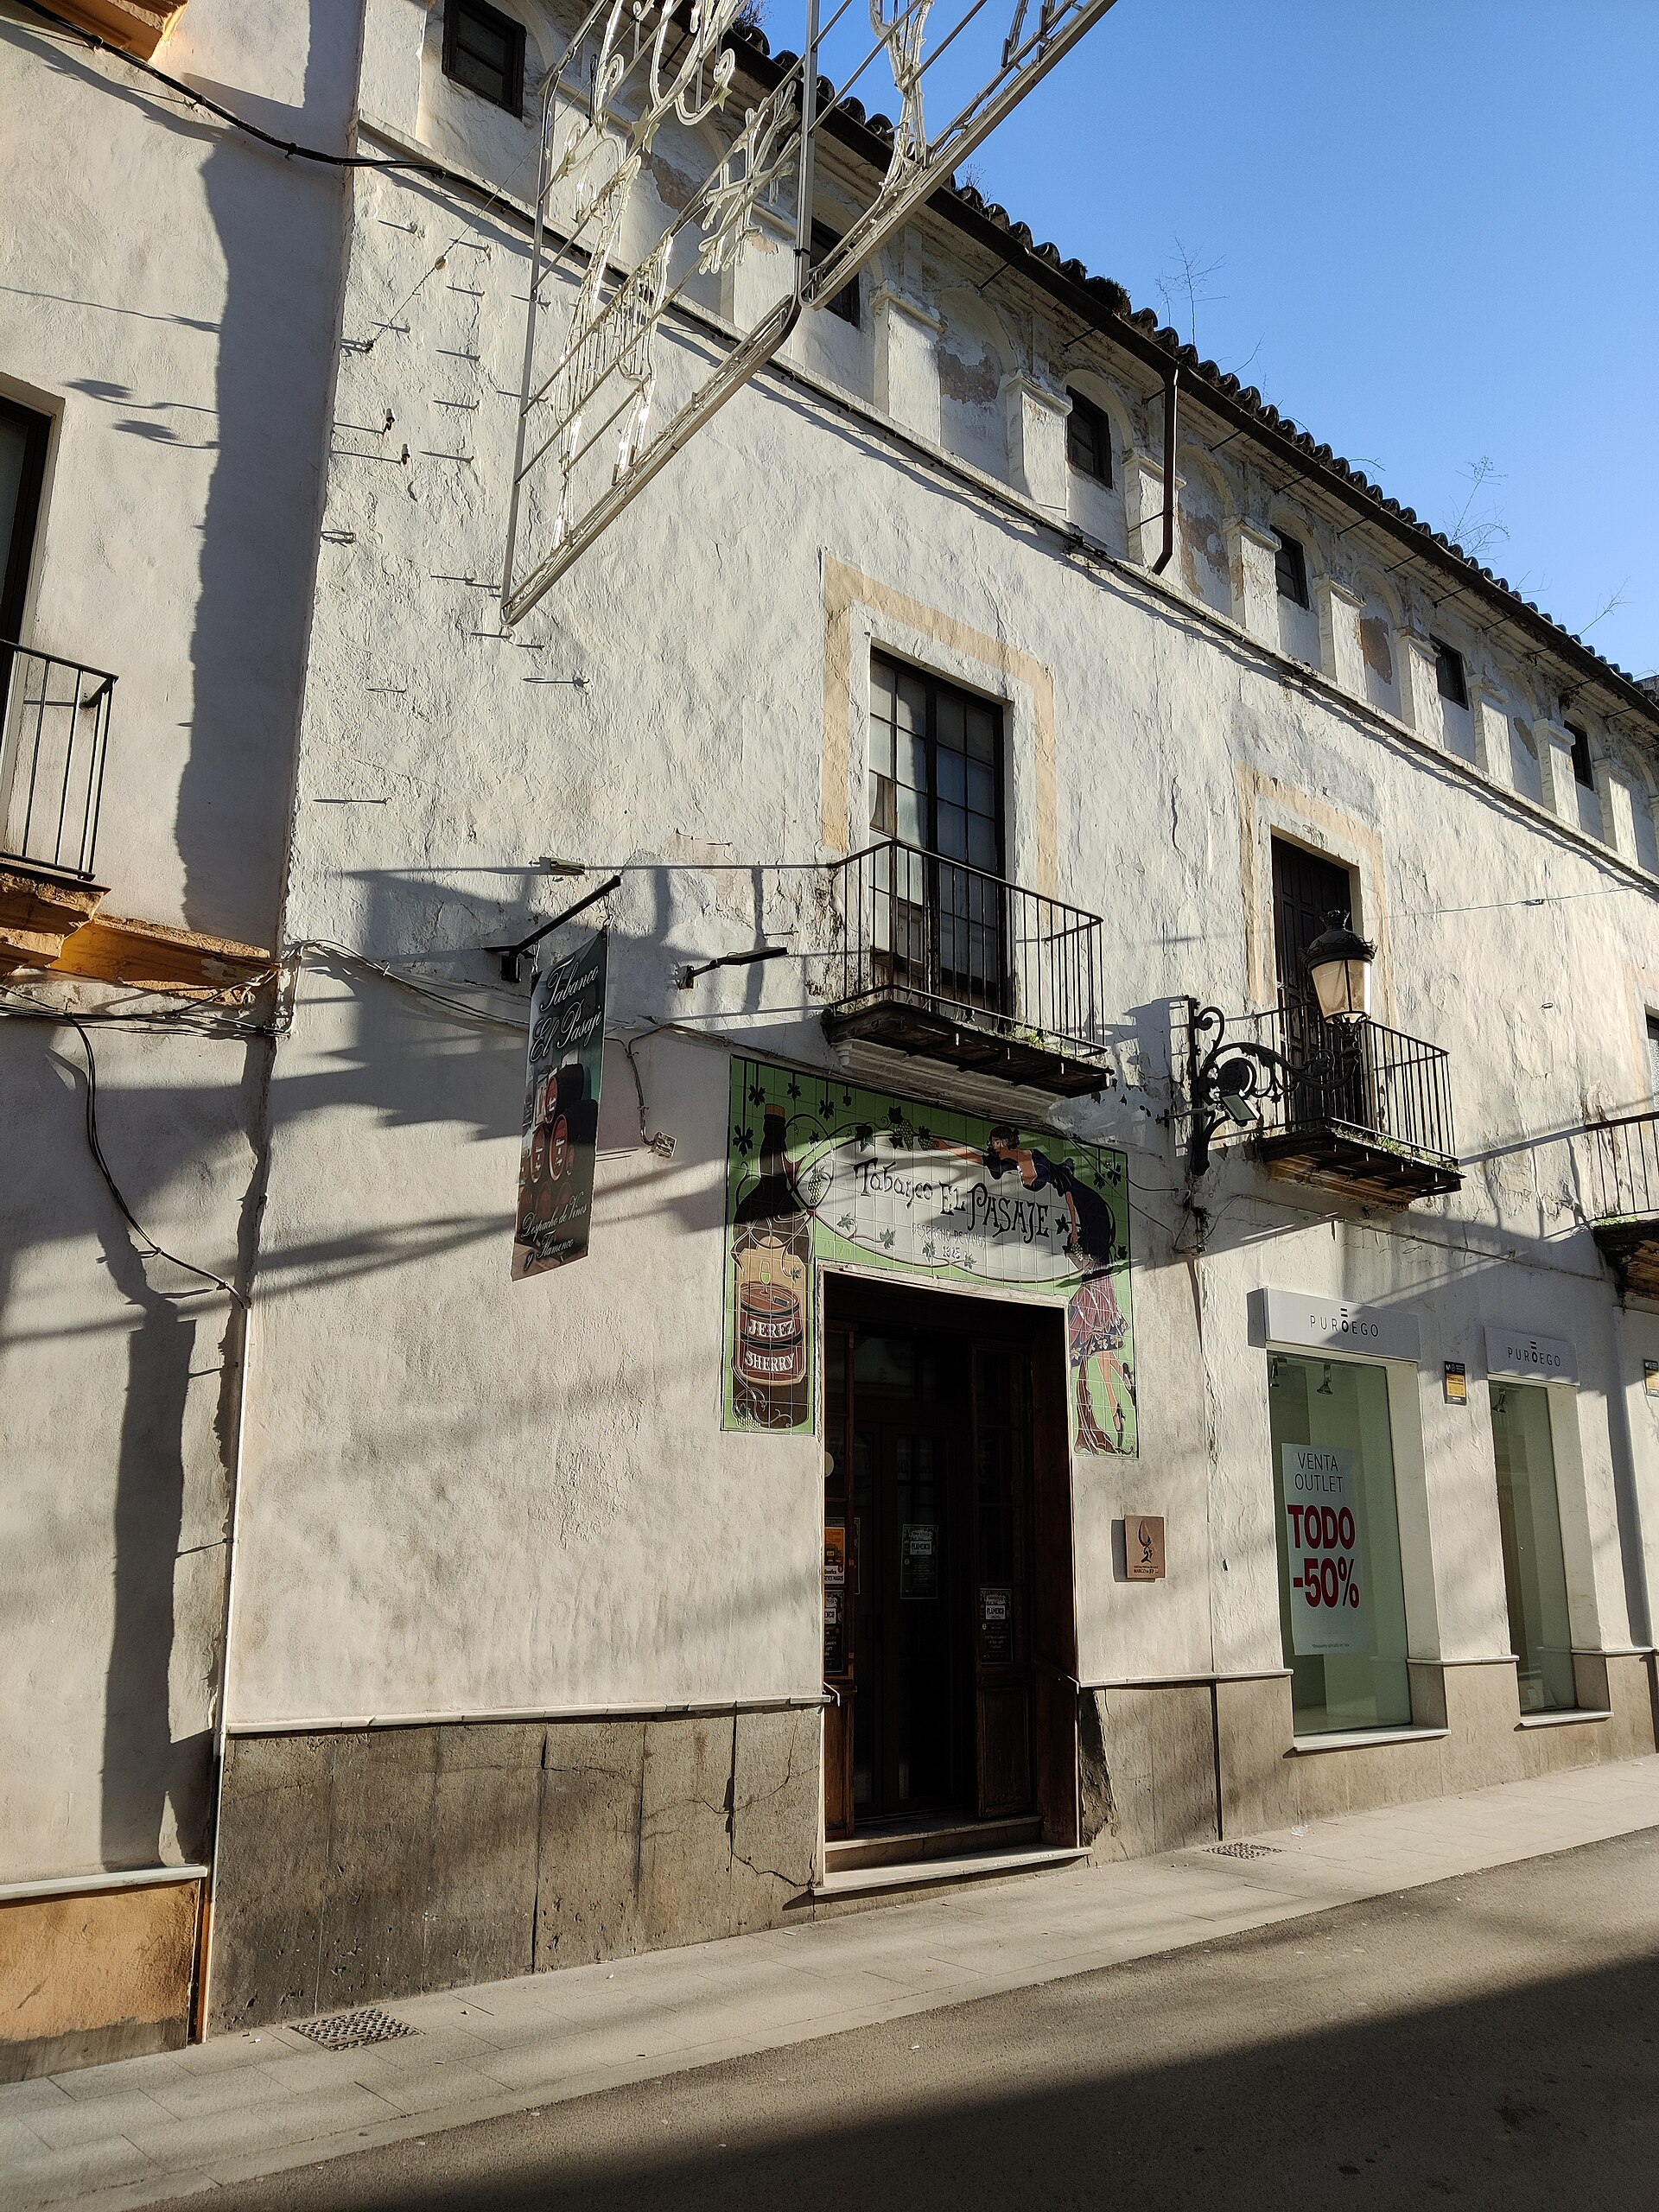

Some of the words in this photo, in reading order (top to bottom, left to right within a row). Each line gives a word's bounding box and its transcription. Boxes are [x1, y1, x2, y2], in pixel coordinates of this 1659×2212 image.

[540, 955, 600, 1012] Tabanco
[530, 1017, 560, 1062] El
[556, 999, 602, 1049] Pasaje
[520, 1206, 559, 1243] Despacho
[558, 1204, 569, 1224] de
[568, 1192, 587, 1220] Vinos
[852, 1157, 933, 1210] Tabanco
[967, 1182, 1050, 1244] PASAJE
[524, 1252, 535, 1272] y
[537, 1230, 574, 1259] Flamenco
[748, 1319, 795, 1338] JEREZ
[1309, 1311, 1379, 1338] PUROEGO
[744, 1350, 795, 1372] SHERRY
[1508, 1344, 1560, 1367] PUROEGO
[1294, 1473, 1343, 1492] OUTLET
[1297, 1452, 1338, 1471] VENTA
[1287, 1503, 1356, 1550] TODO
[1293, 1556, 1360, 1609] -50%
